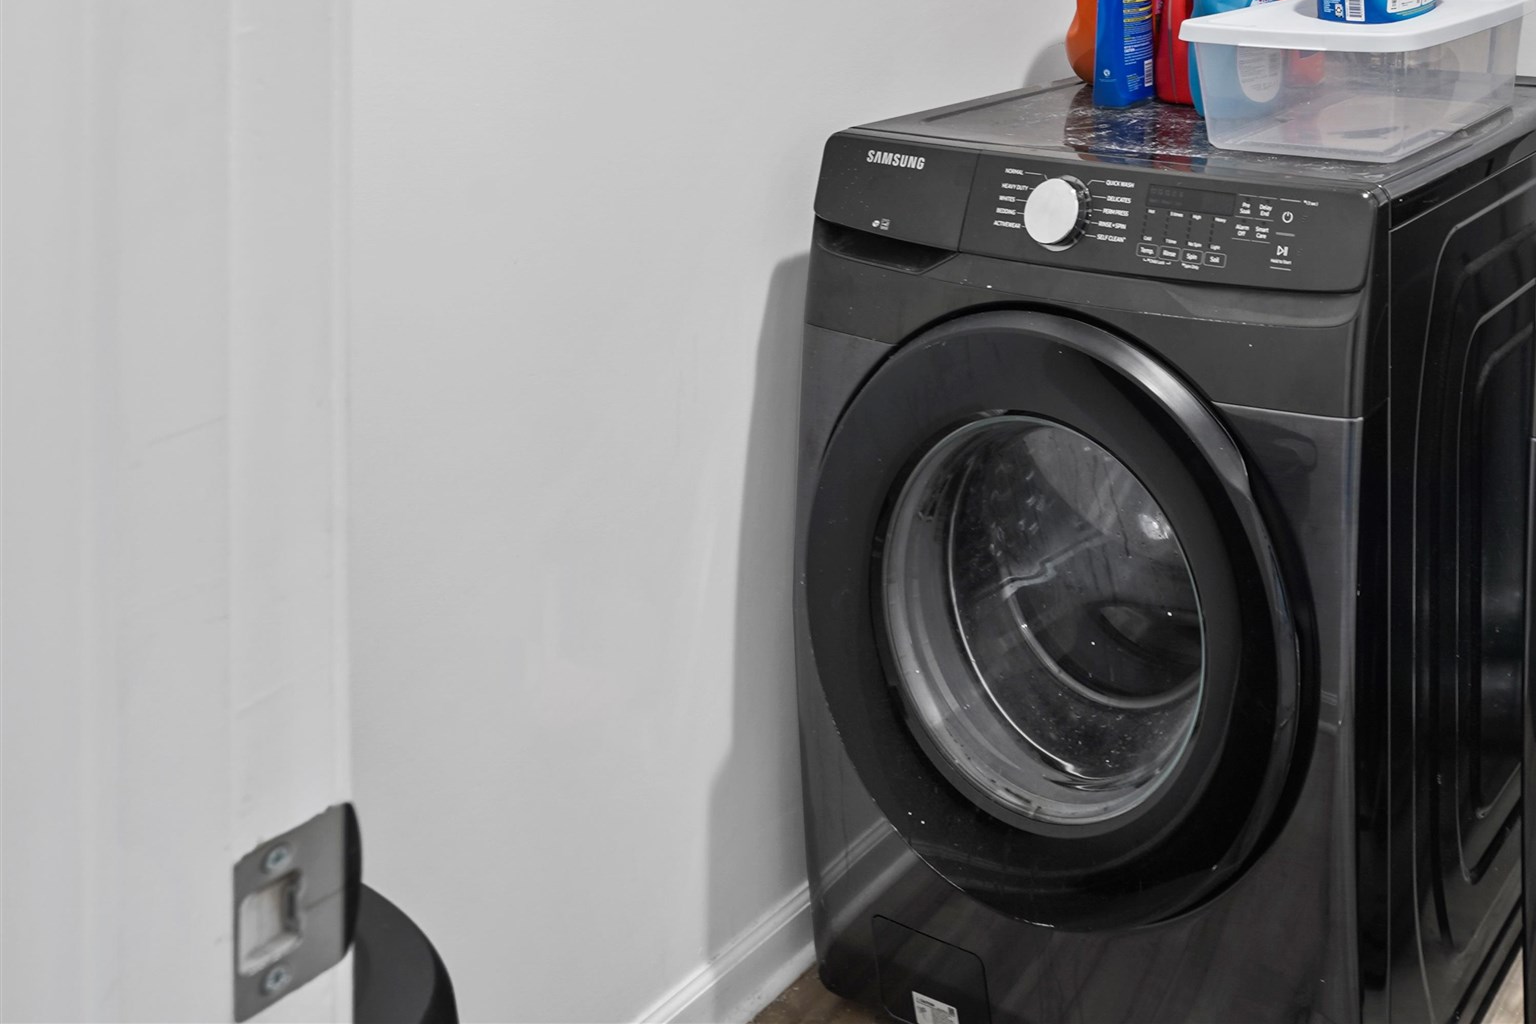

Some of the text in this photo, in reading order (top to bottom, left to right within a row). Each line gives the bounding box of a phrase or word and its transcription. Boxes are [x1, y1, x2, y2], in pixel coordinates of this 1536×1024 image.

[866, 149, 926, 170] SAMSUNG
[1004, 167, 1025, 176] NORMAL
[1001, 182, 1017, 190] HEAVY
[1105, 179, 1120, 187] QUICK
[998, 195, 1017, 203] WHITES
[1106, 195, 1132, 204] DELICATES
[995, 207, 1017, 216] BEDDING
[1102, 207, 1130, 217] PERM PRESS
[992, 219, 1021, 229] ACTIVEWEAR
[1096, 233, 1108, 241] SELF
[1186, 252, 1198, 261] Spin
[1209, 256, 1220, 264] Soil
